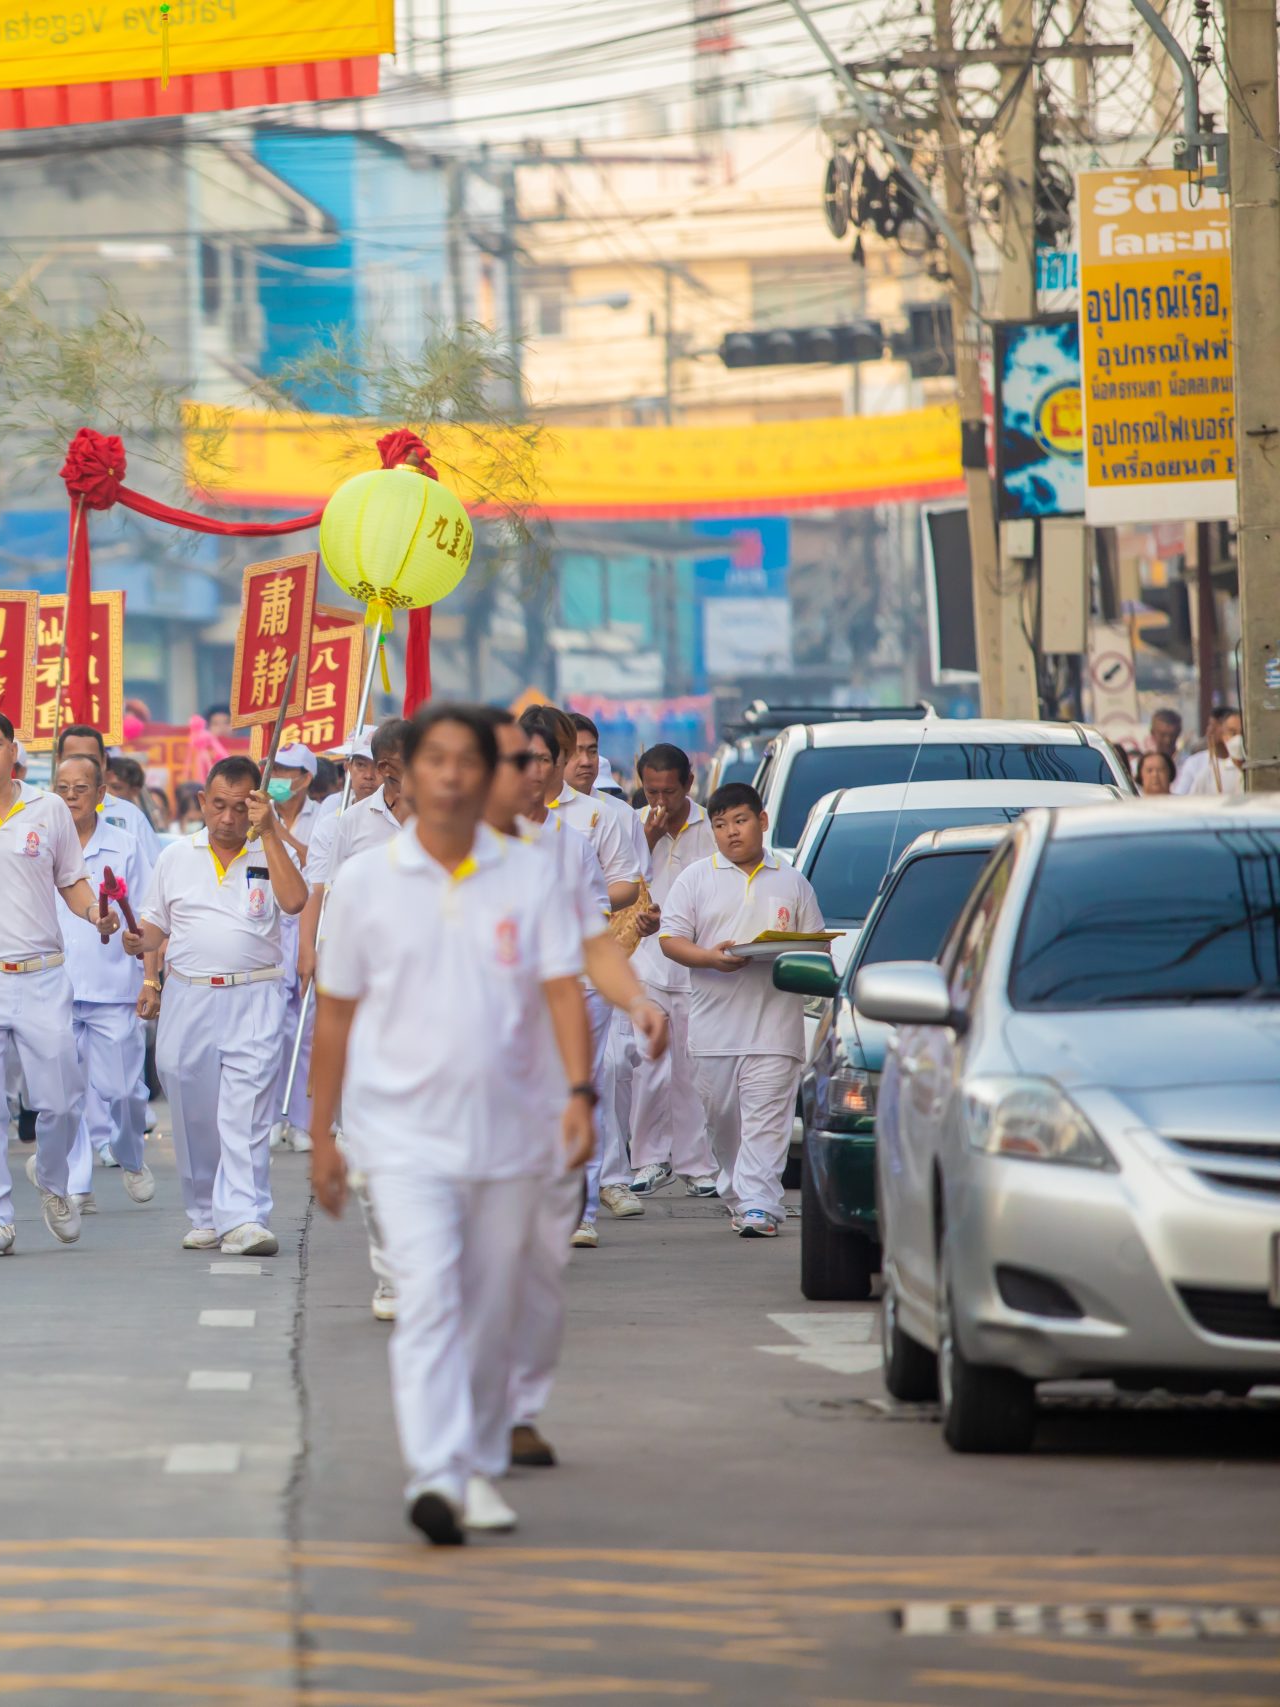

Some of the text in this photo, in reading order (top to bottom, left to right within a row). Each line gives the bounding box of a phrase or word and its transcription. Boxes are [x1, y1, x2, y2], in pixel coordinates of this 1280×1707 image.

[1093, 176, 1231, 217] รัตน
[1099, 220, 1231, 257] โลหะภั
[1097, 329, 1229, 376] อุปกรณ์ไฟฟ้
